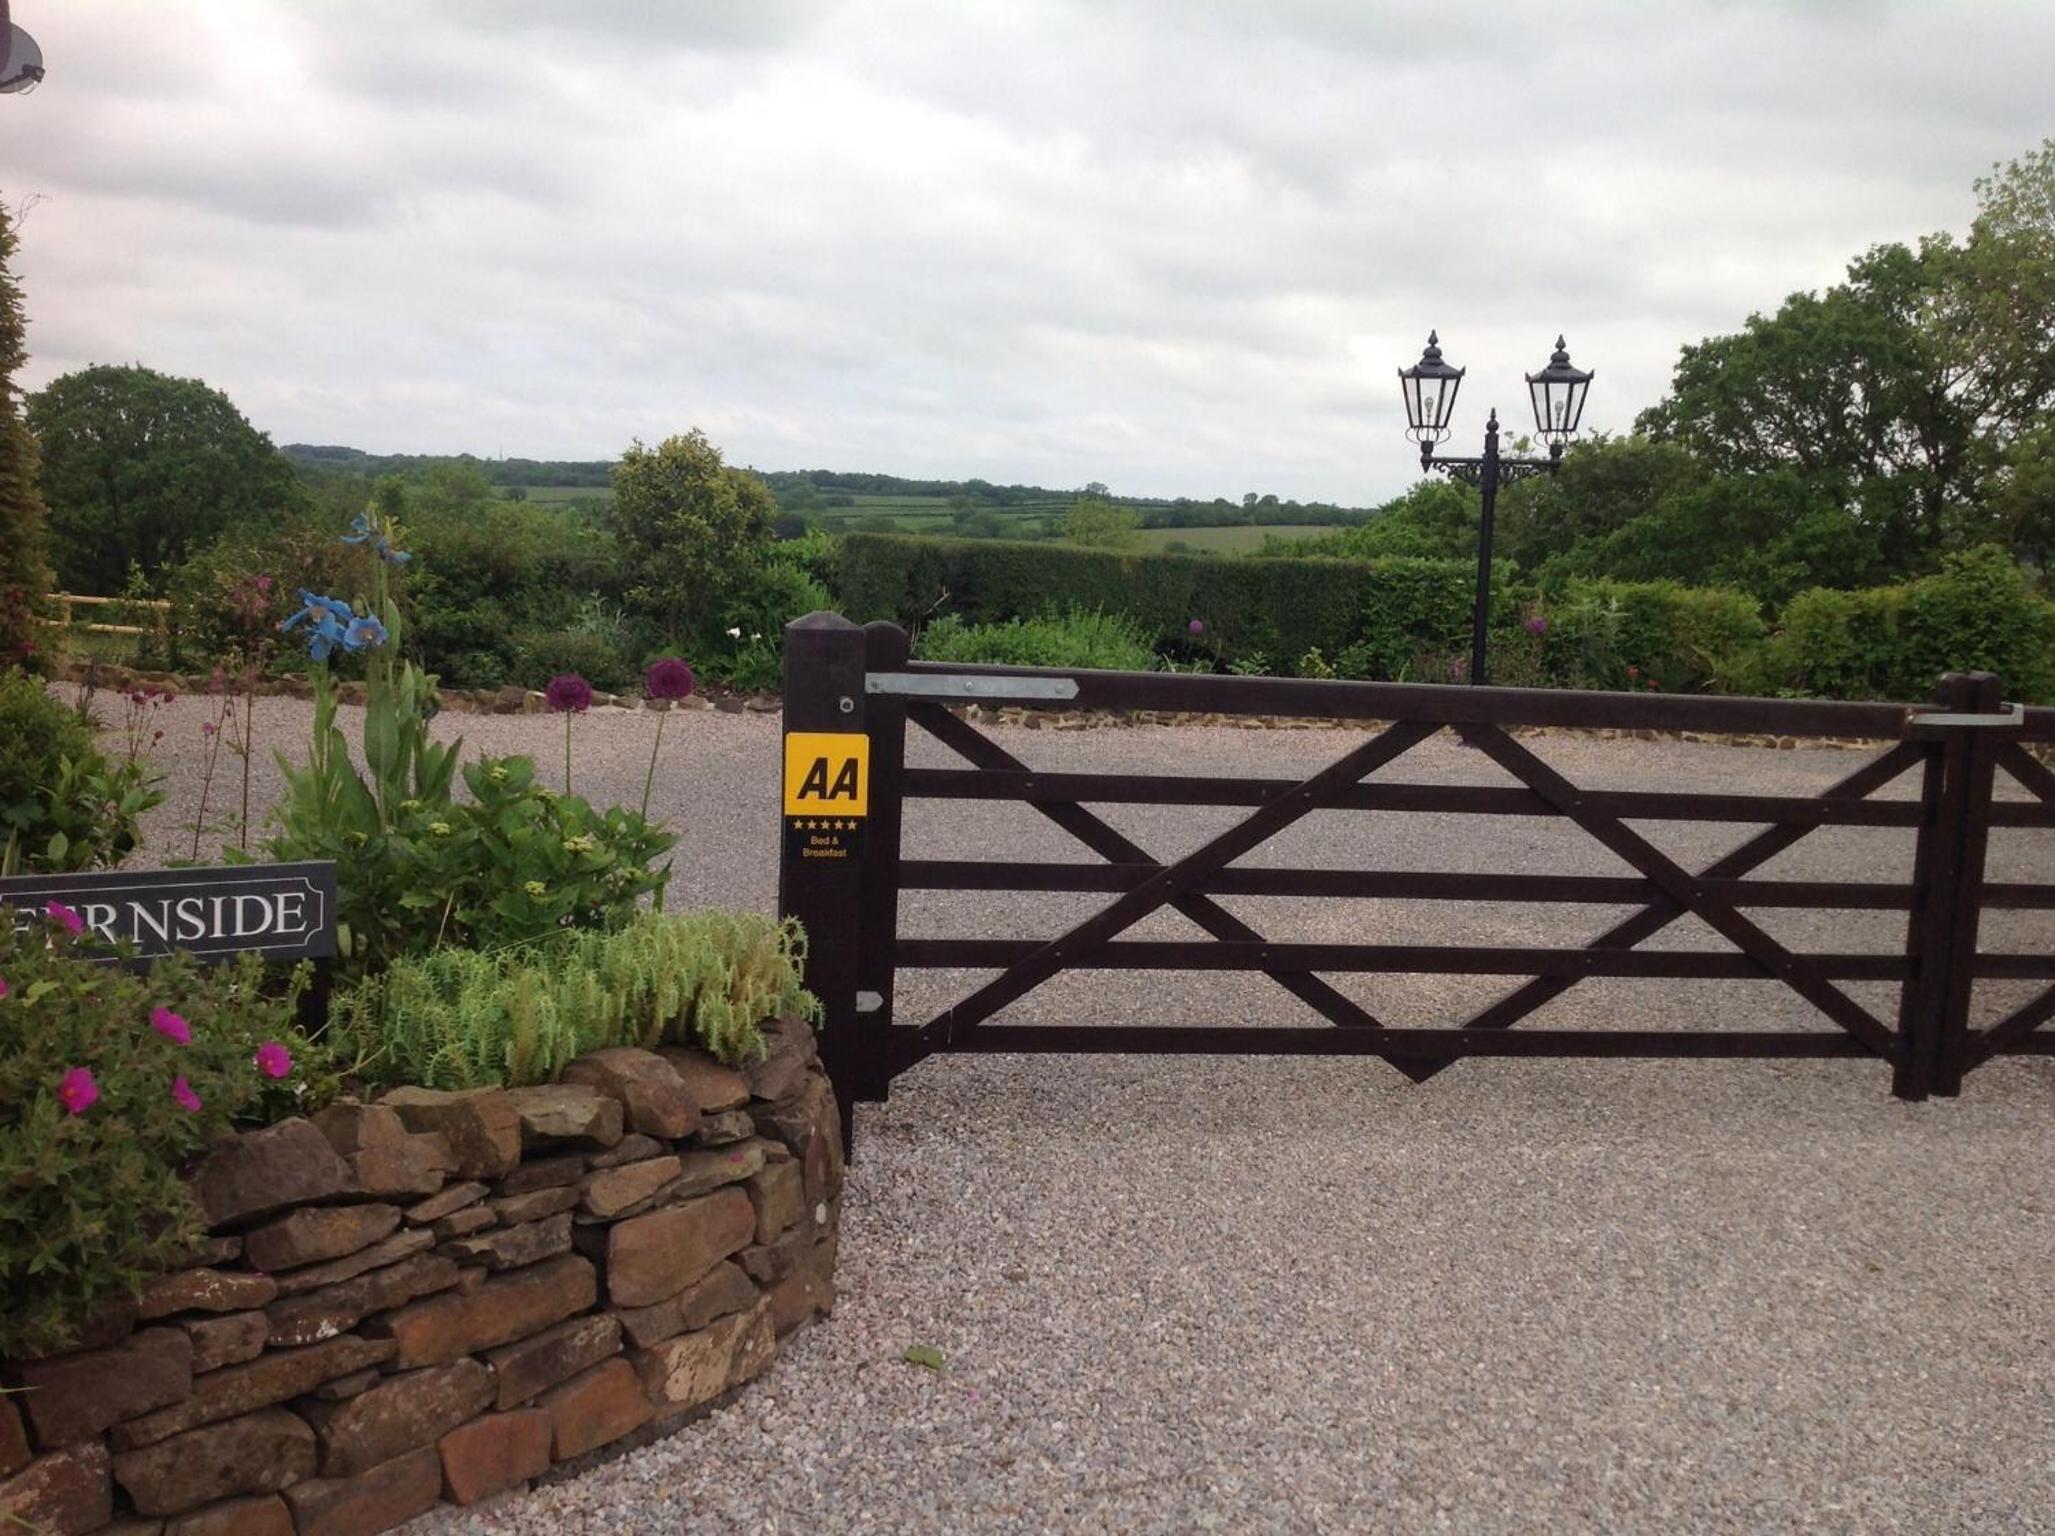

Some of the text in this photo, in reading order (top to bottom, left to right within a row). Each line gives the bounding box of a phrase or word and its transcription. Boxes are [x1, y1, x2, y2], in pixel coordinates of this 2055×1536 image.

[797, 757, 858, 800] AA
[811, 835, 839, 845] Bed &
[802, 847, 847, 857] Breakfast
